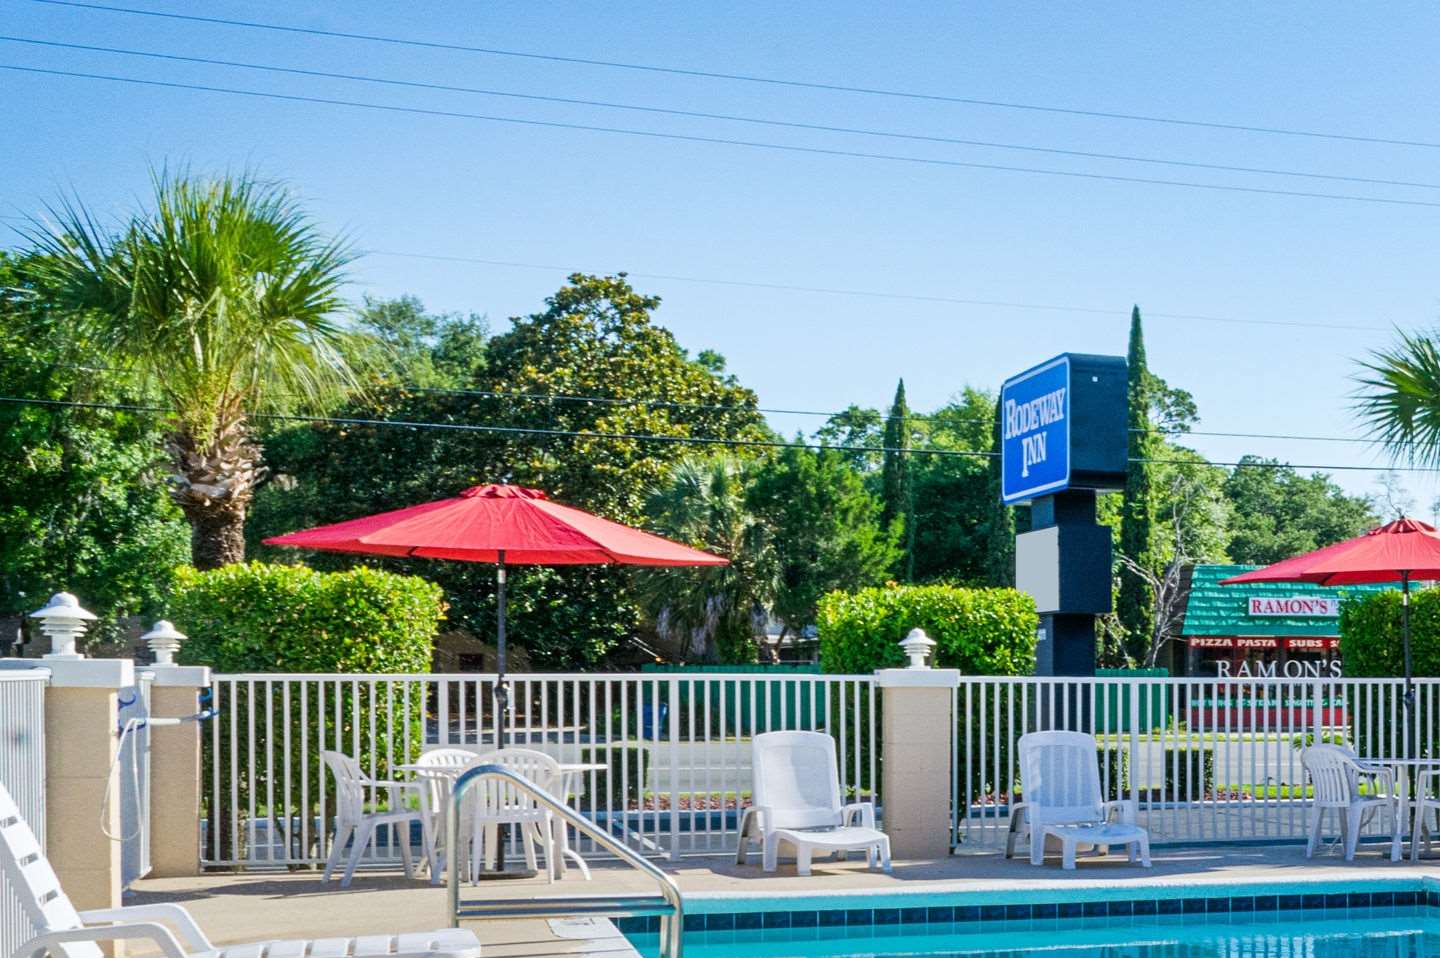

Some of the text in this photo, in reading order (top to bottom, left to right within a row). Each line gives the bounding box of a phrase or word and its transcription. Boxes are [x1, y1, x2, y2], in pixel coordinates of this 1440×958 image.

[1005, 387, 1066, 440] RODEWAY
[1021, 431, 1047, 478] INN
[1251, 599, 1329, 614] RAMON'S
[1190, 638, 1233, 647] PIZZA
[1237, 639, 1277, 648] PASTA
[1288, 639, 1324, 648] SUBS
[1215, 659, 1343, 678] RAMON'S
